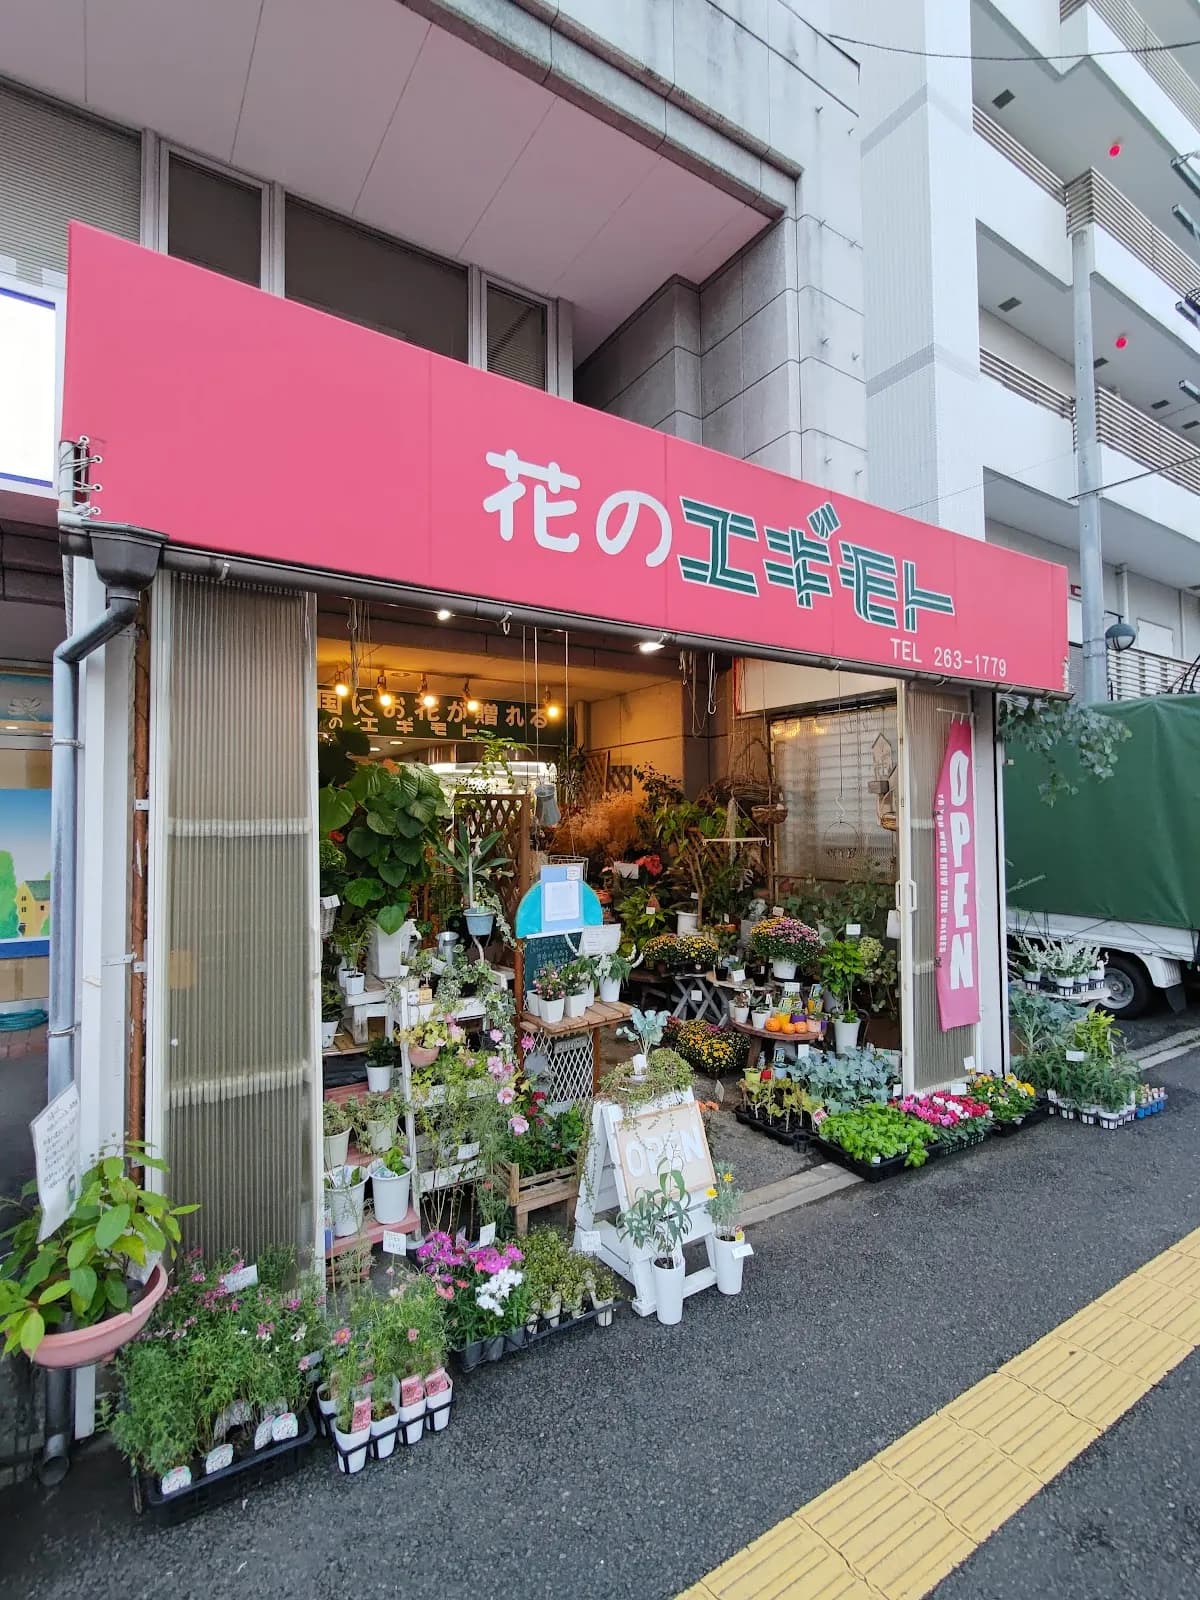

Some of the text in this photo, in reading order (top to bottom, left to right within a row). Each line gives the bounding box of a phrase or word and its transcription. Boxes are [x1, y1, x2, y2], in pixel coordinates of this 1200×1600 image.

[483, 449, 955, 634] 花のエギモト
[889, 638, 1006, 677] TEL 263-1779
[949, 750, 973, 989] OPEN
